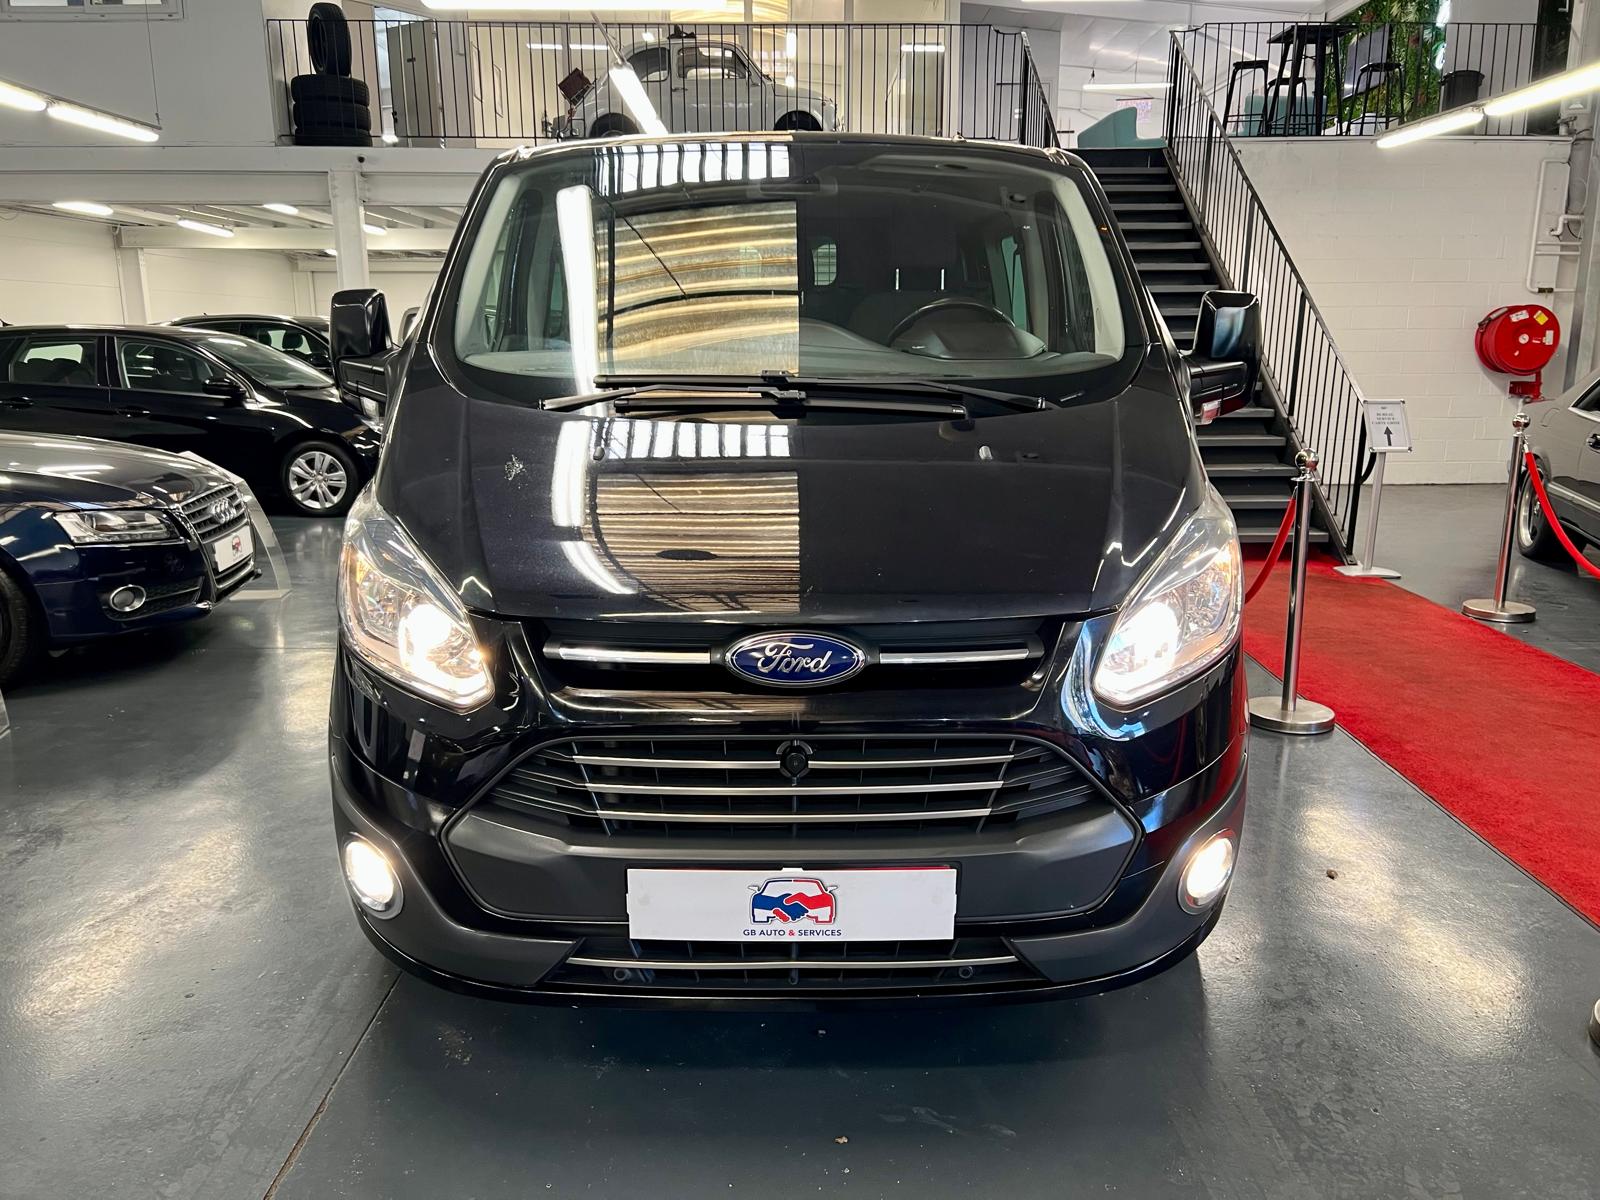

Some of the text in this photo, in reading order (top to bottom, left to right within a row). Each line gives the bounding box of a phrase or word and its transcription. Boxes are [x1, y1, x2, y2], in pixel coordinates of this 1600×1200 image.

[757, 641, 833, 674] Ford
[743, 929, 842, 937] GB AUTO & SERVICES
